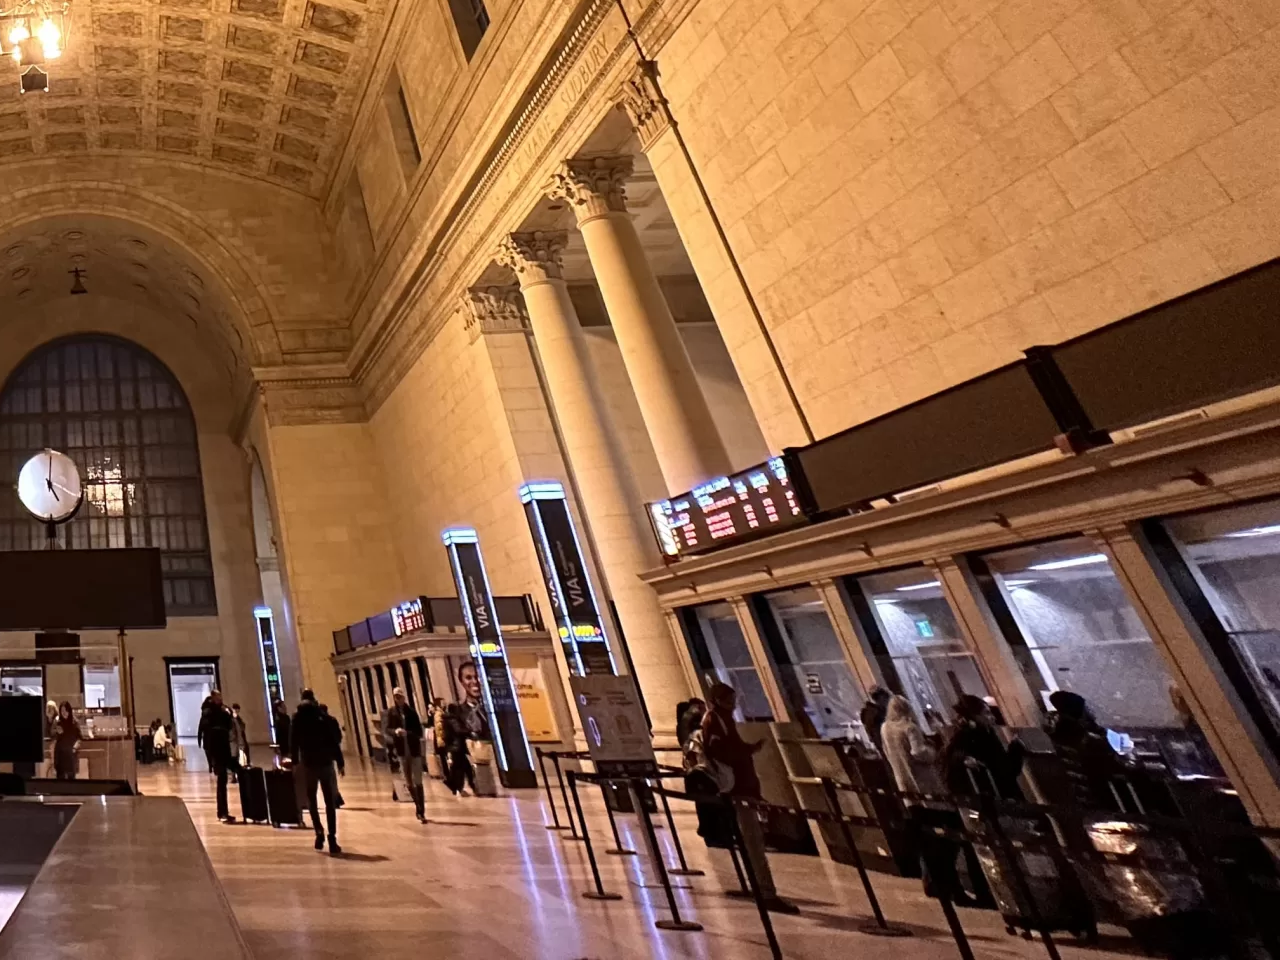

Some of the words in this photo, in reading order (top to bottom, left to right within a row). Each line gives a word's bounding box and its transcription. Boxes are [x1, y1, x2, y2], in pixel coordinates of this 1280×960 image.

[560, 31, 612, 113] SUDBURY
[565, 577, 585, 607] VIA
[475, 605, 490, 629] VIA
